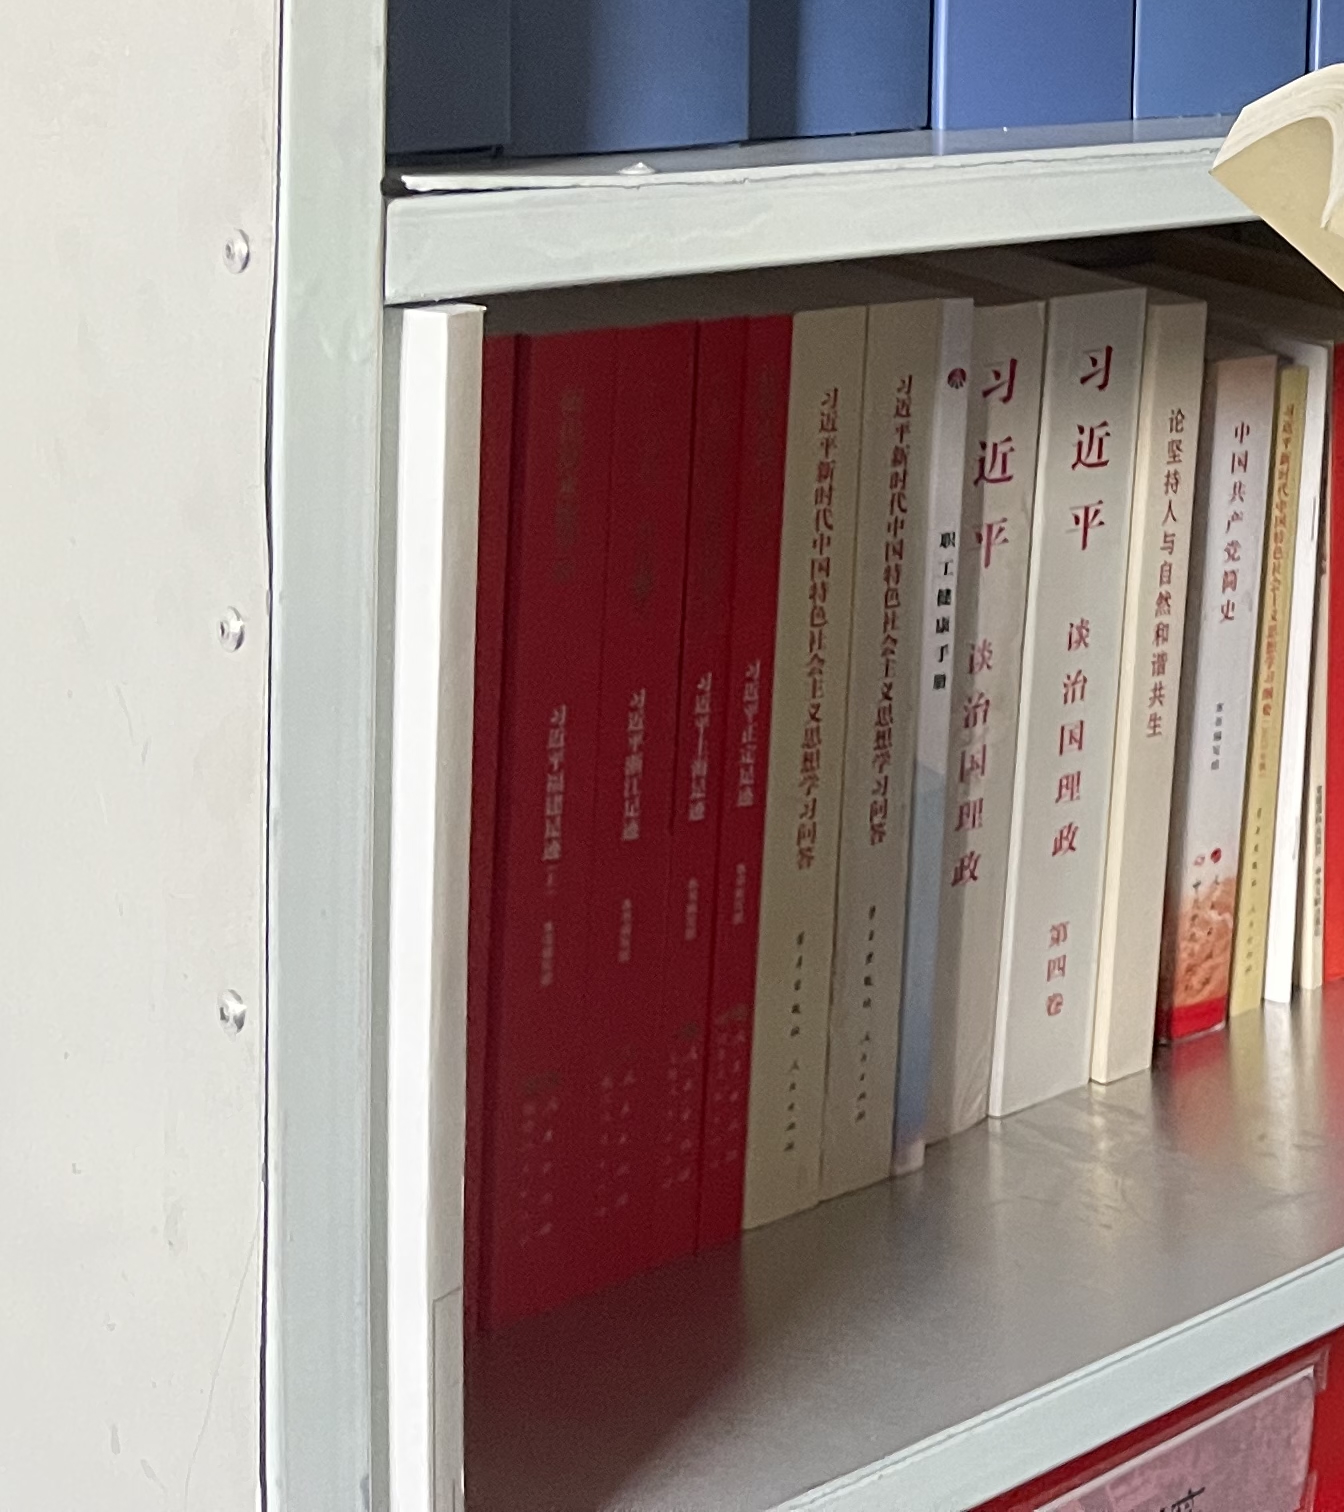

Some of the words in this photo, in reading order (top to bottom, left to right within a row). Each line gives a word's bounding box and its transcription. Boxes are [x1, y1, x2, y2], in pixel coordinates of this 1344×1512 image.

[973, 358, 1018, 569] 习近平
[1067, 345, 1113, 552] 习近平
[1220, 420, 1251, 623] 中国共产党简史
[1146, 408, 1186, 738] 论坚持人与自然和谐共生
[951, 638, 994, 887] 谈治国理政
[1051, 619, 1090, 857] 谈治国理政
